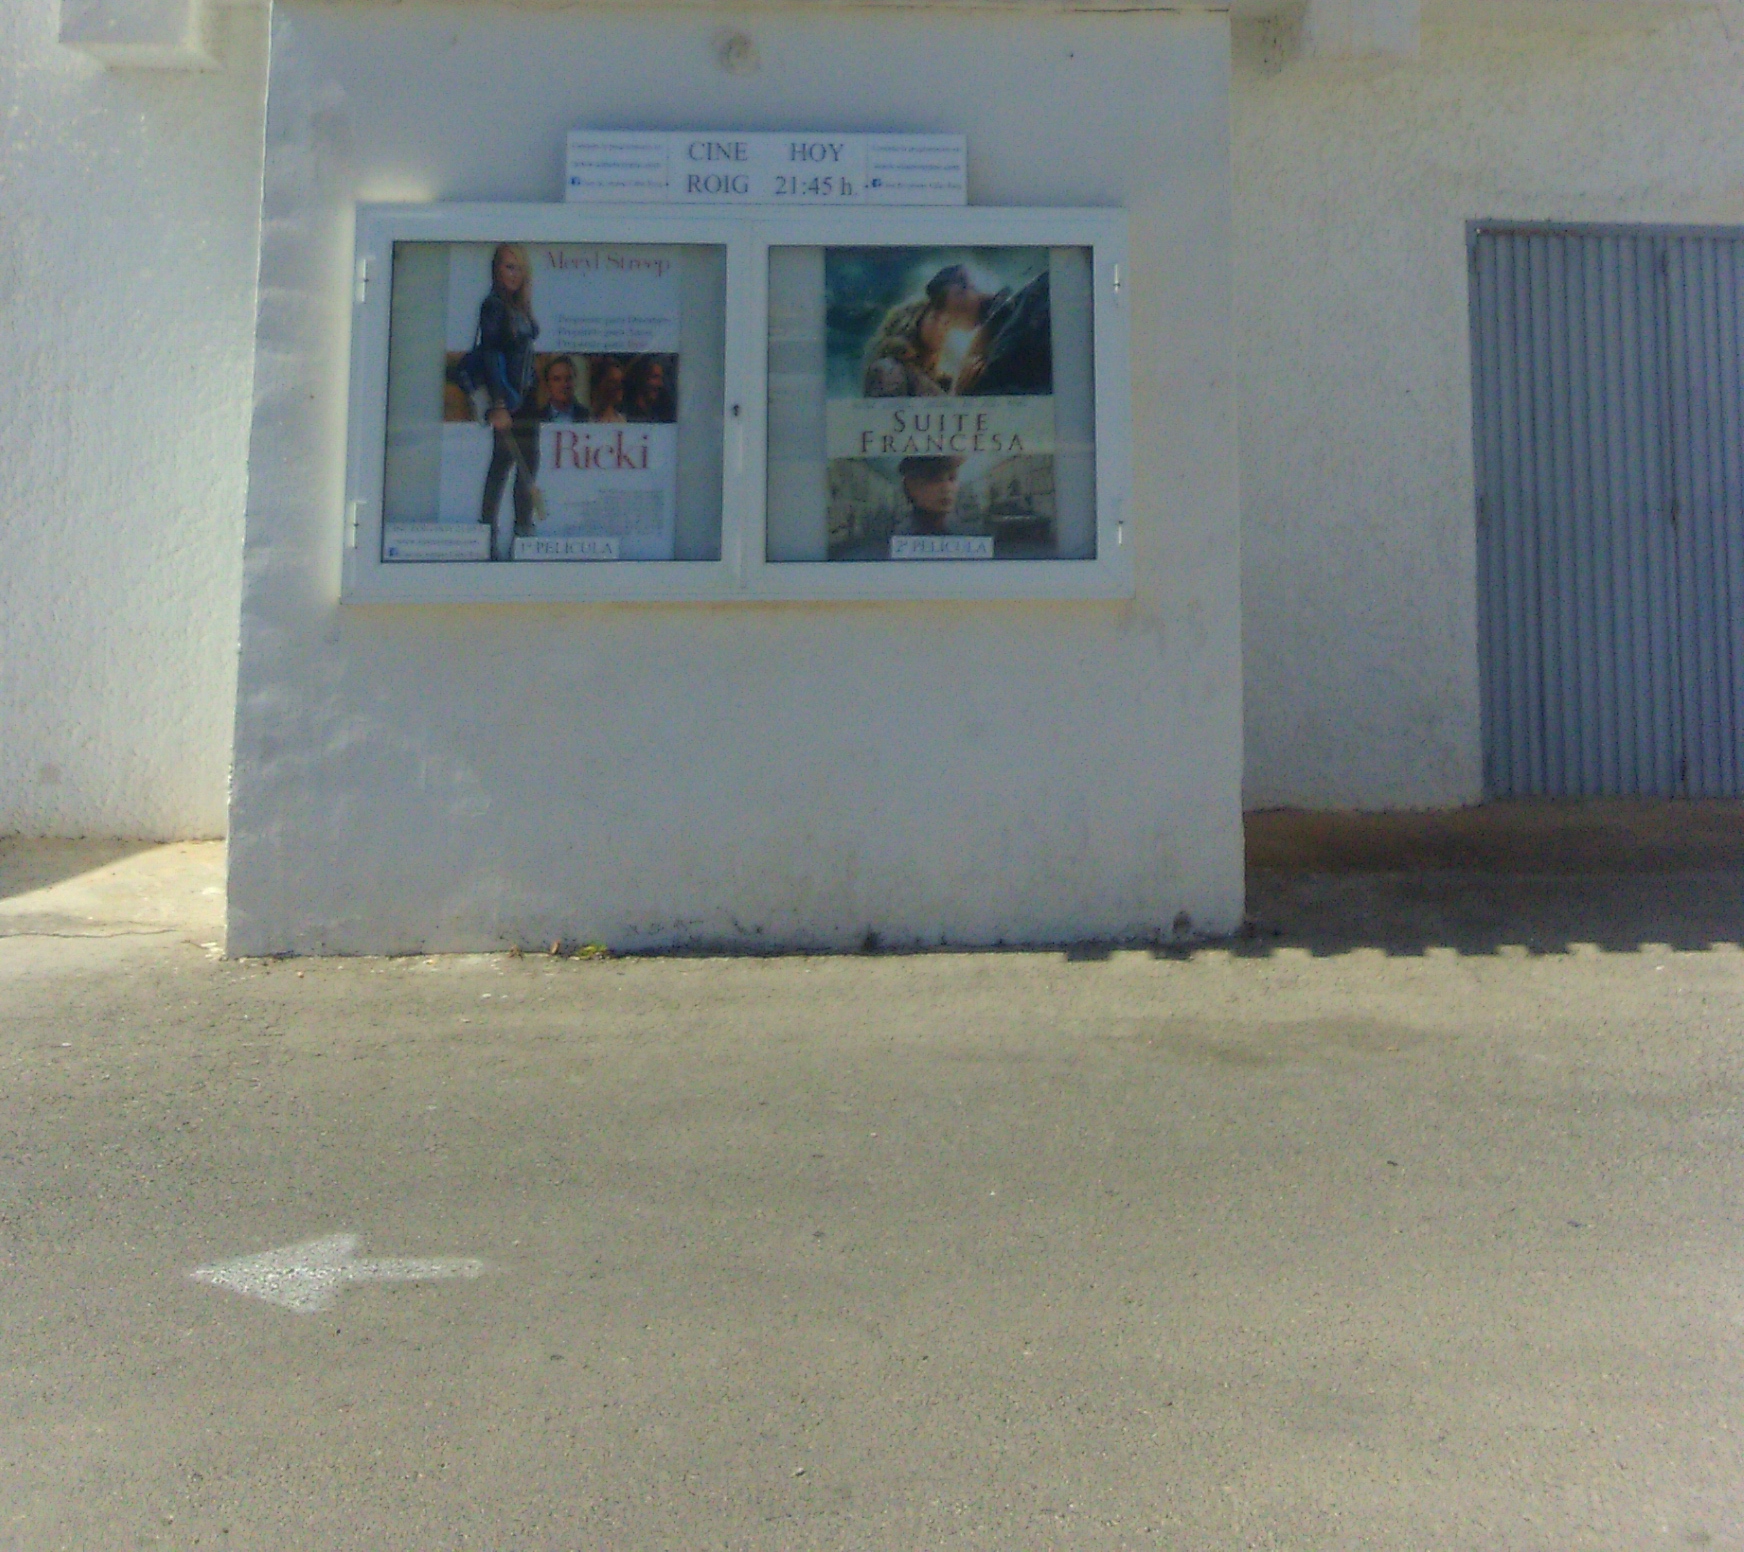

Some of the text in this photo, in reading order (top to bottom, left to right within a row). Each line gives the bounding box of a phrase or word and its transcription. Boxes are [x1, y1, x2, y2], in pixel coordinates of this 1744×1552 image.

[687, 141, 748, 162] CINE
[790, 142, 844, 162] HOY
[686, 174, 749, 194] ROIG
[774, 175, 833, 196] 21:45
[893, 409, 989, 433] SUITE
[553, 430, 649, 469] Ricki
[861, 430, 1025, 453] FRANCESA
